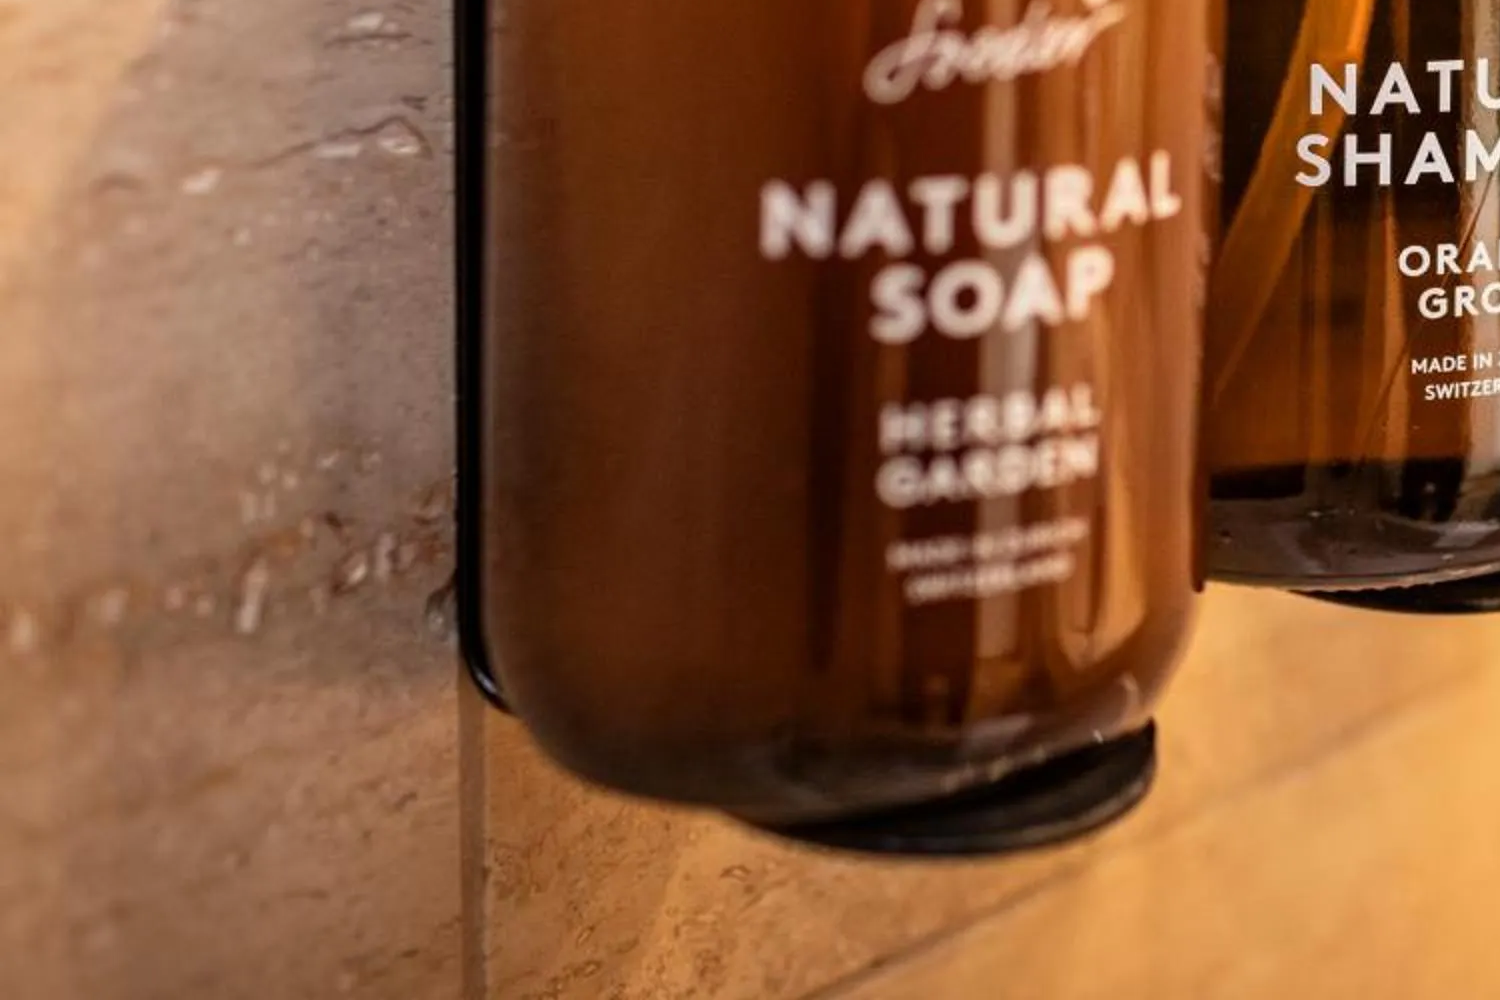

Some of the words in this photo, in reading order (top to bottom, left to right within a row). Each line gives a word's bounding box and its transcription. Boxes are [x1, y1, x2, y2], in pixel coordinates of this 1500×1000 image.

[759, 149, 1182, 260] NATURAL
[869, 245, 1115, 345] SOAP
[1411, 354, 1467, 374] MADE
[1473, 352, 1493, 369] IN
